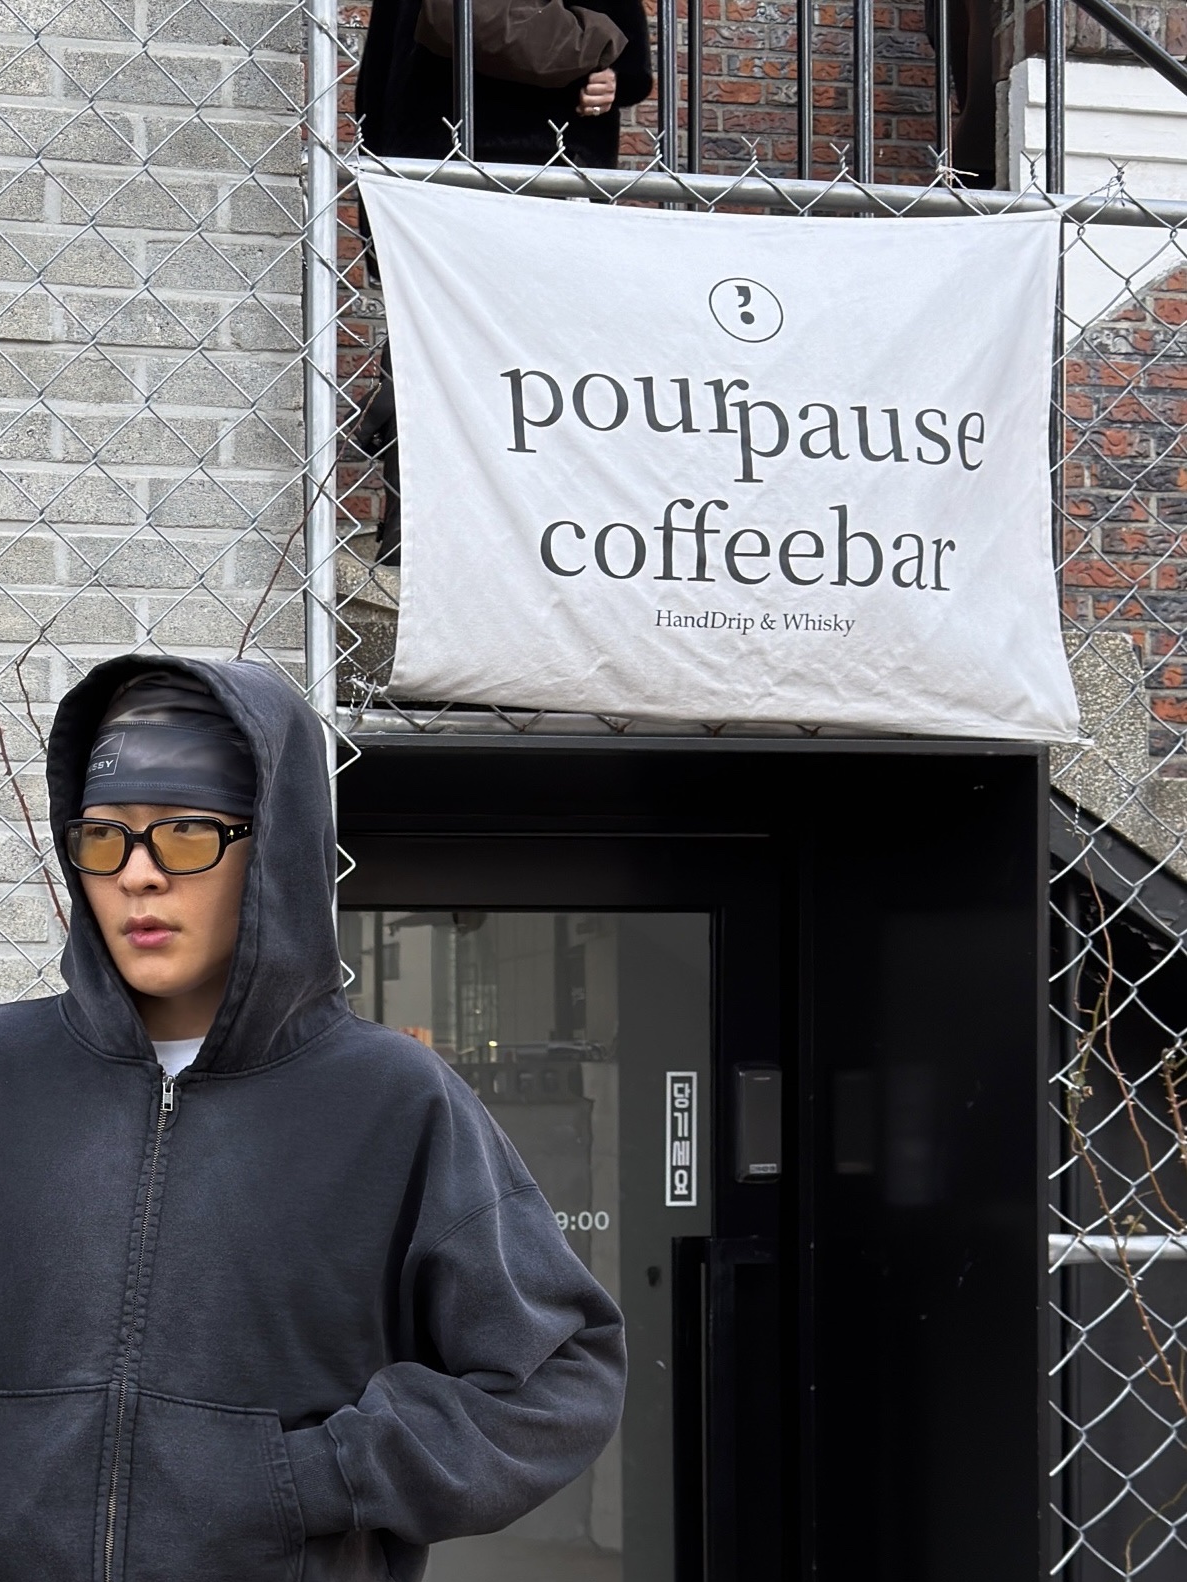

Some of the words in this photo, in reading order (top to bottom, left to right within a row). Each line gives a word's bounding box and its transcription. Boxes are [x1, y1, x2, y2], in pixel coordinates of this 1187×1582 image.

[540, 498, 956, 591] coffeebar
[654, 609, 755, 636] HandDrip
[760, 612, 777, 631] &
[782, 612, 856, 637] Whisky
[672, 1083, 691, 1195] 당기세요
